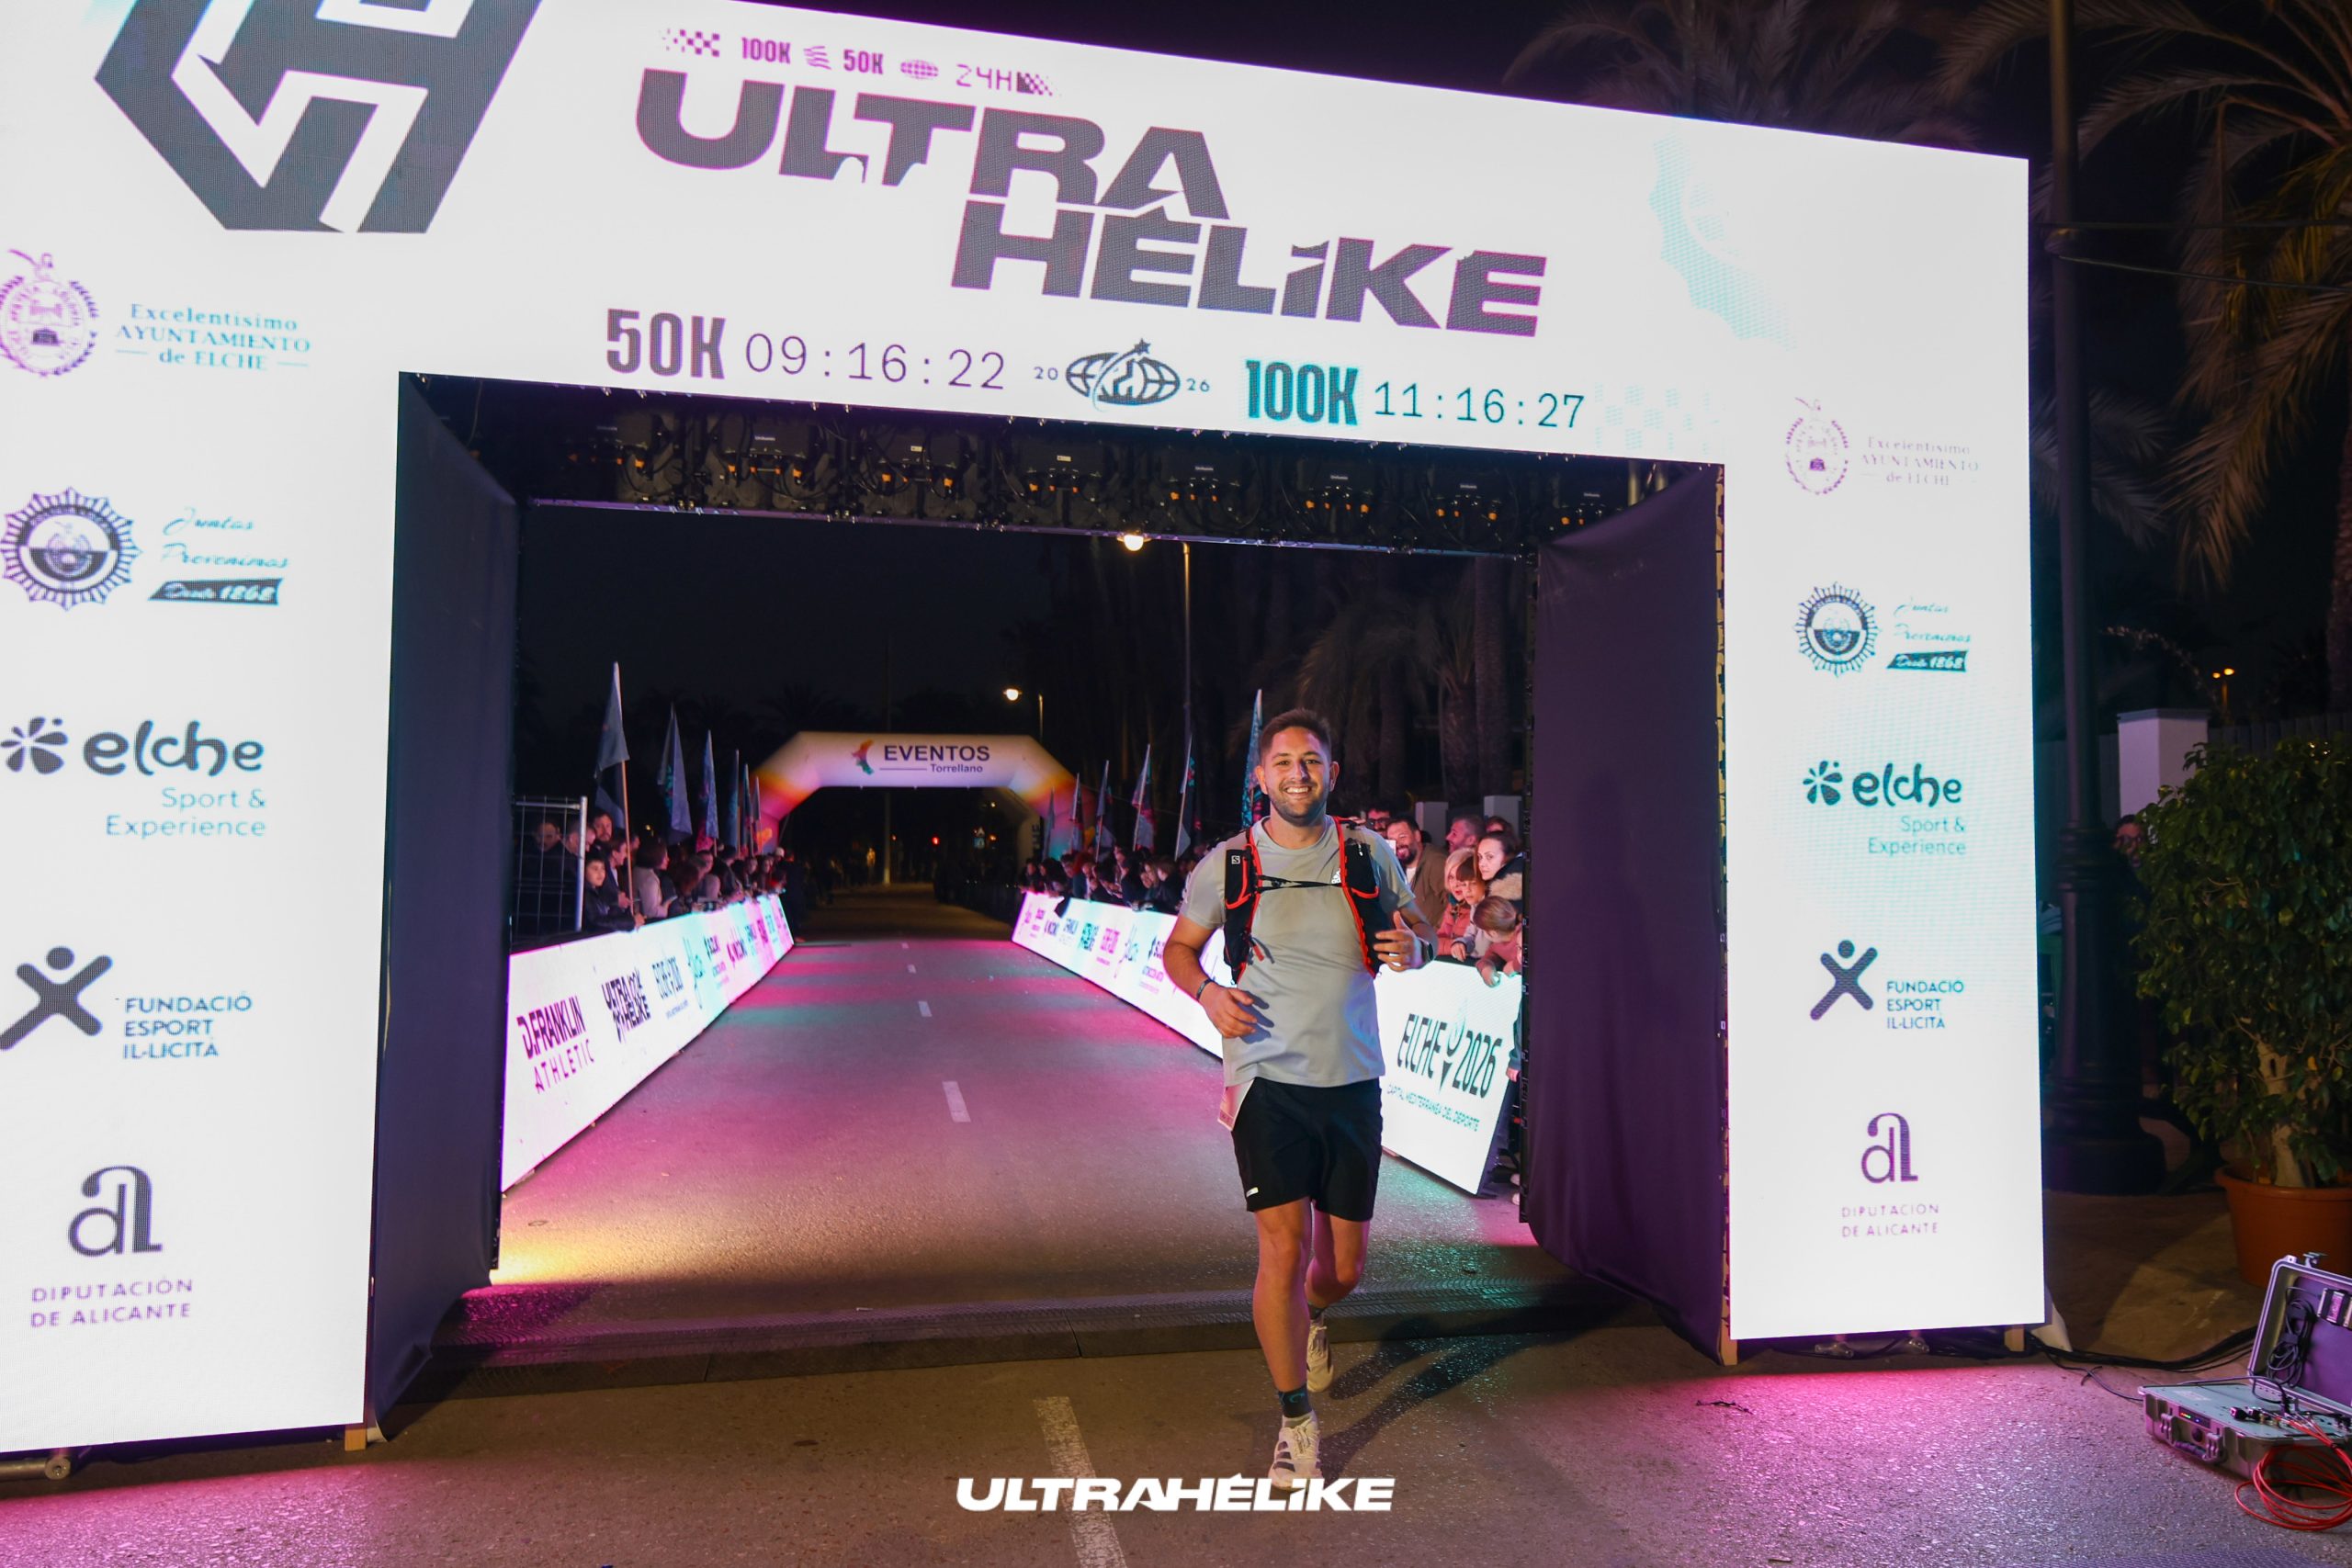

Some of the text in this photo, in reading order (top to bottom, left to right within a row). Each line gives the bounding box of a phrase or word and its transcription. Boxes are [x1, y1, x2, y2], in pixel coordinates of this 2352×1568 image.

[741, 37, 1012, 92] 100K 50K 24H
[635, 68, 1229, 220] ULTRA
[116, 325, 311, 354] AYUNTAMIENTO
[606, 309, 1005, 390] 50K 09:16:22
[159, 348, 267, 371] de ELCHE
[1034, 366, 1210, 392] 20 26
[1246, 359, 1585, 427] 100K 11:16:27
[1886, 471, 1903, 482] de
[220, 585, 277, 602] 1868
[1930, 655, 1963, 669] 1868
[83, 720, 265, 777] elche
[884, 745, 990, 761] EVENTOS
[931, 763, 984, 773] Torrellano
[1852, 762, 1962, 807] elche
[161, 787, 267, 811] Sport &
[106, 815, 267, 840] Experience
[1901, 816, 1965, 836] Sport &
[1868, 837, 1966, 857] Experience
[1886, 998, 1941, 1011] ESPORT
[124, 1019, 214, 1037] ESPORT
[515, 996, 586, 1059] D.FRANKLIN
[534, 1039, 594, 1094] ATHLETIC
[1396, 1013, 1503, 1099] ELCHE 2026
[1841, 1222, 1938, 1237] DE ALICANTE
[30, 1303, 191, 1328] DE ALICANTE
